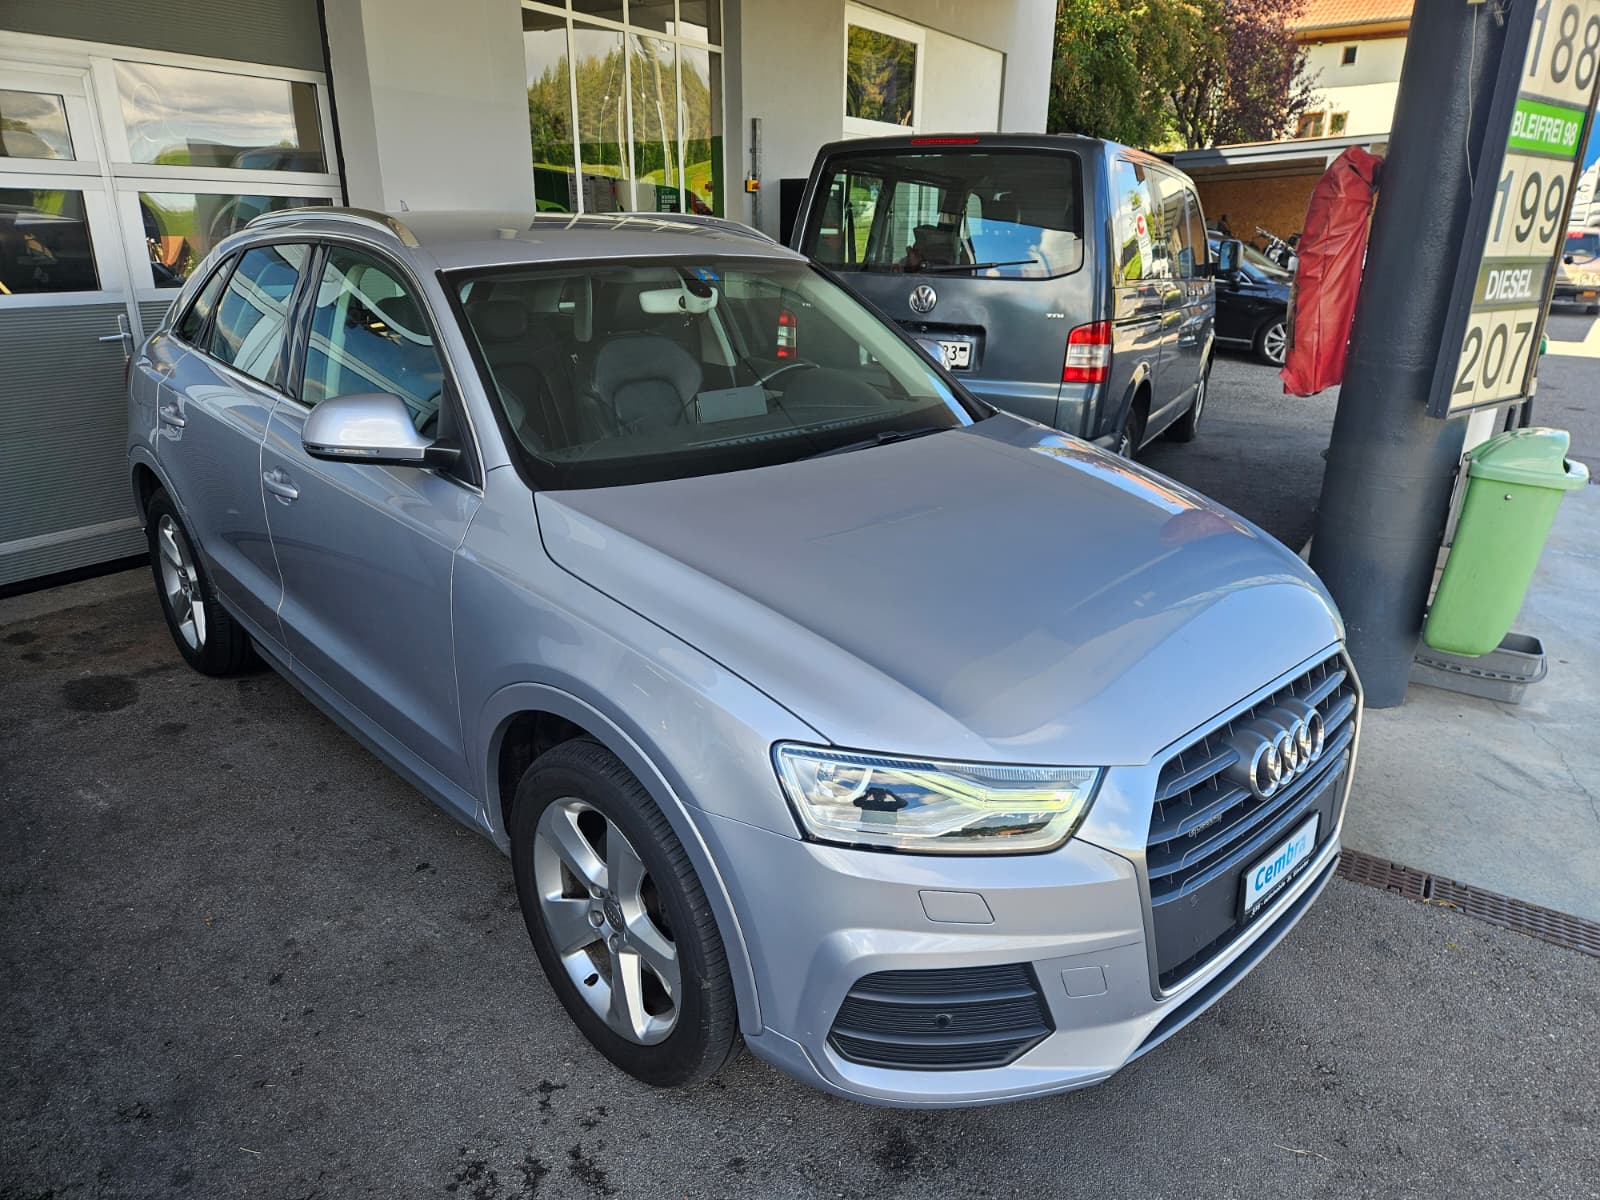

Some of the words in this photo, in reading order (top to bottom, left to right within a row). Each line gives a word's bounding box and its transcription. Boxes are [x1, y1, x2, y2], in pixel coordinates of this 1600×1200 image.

[1529, 0, 1600, 90] 188
[1511, 110, 1564, 144] BLEIFREI
[1562, 121, 1579, 147] 98
[1493, 170, 1565, 243] 199
[1485, 269, 1532, 300] DIESEL
[1453, 322, 1533, 394] 207
[1254, 835, 1308, 891] Cembra
